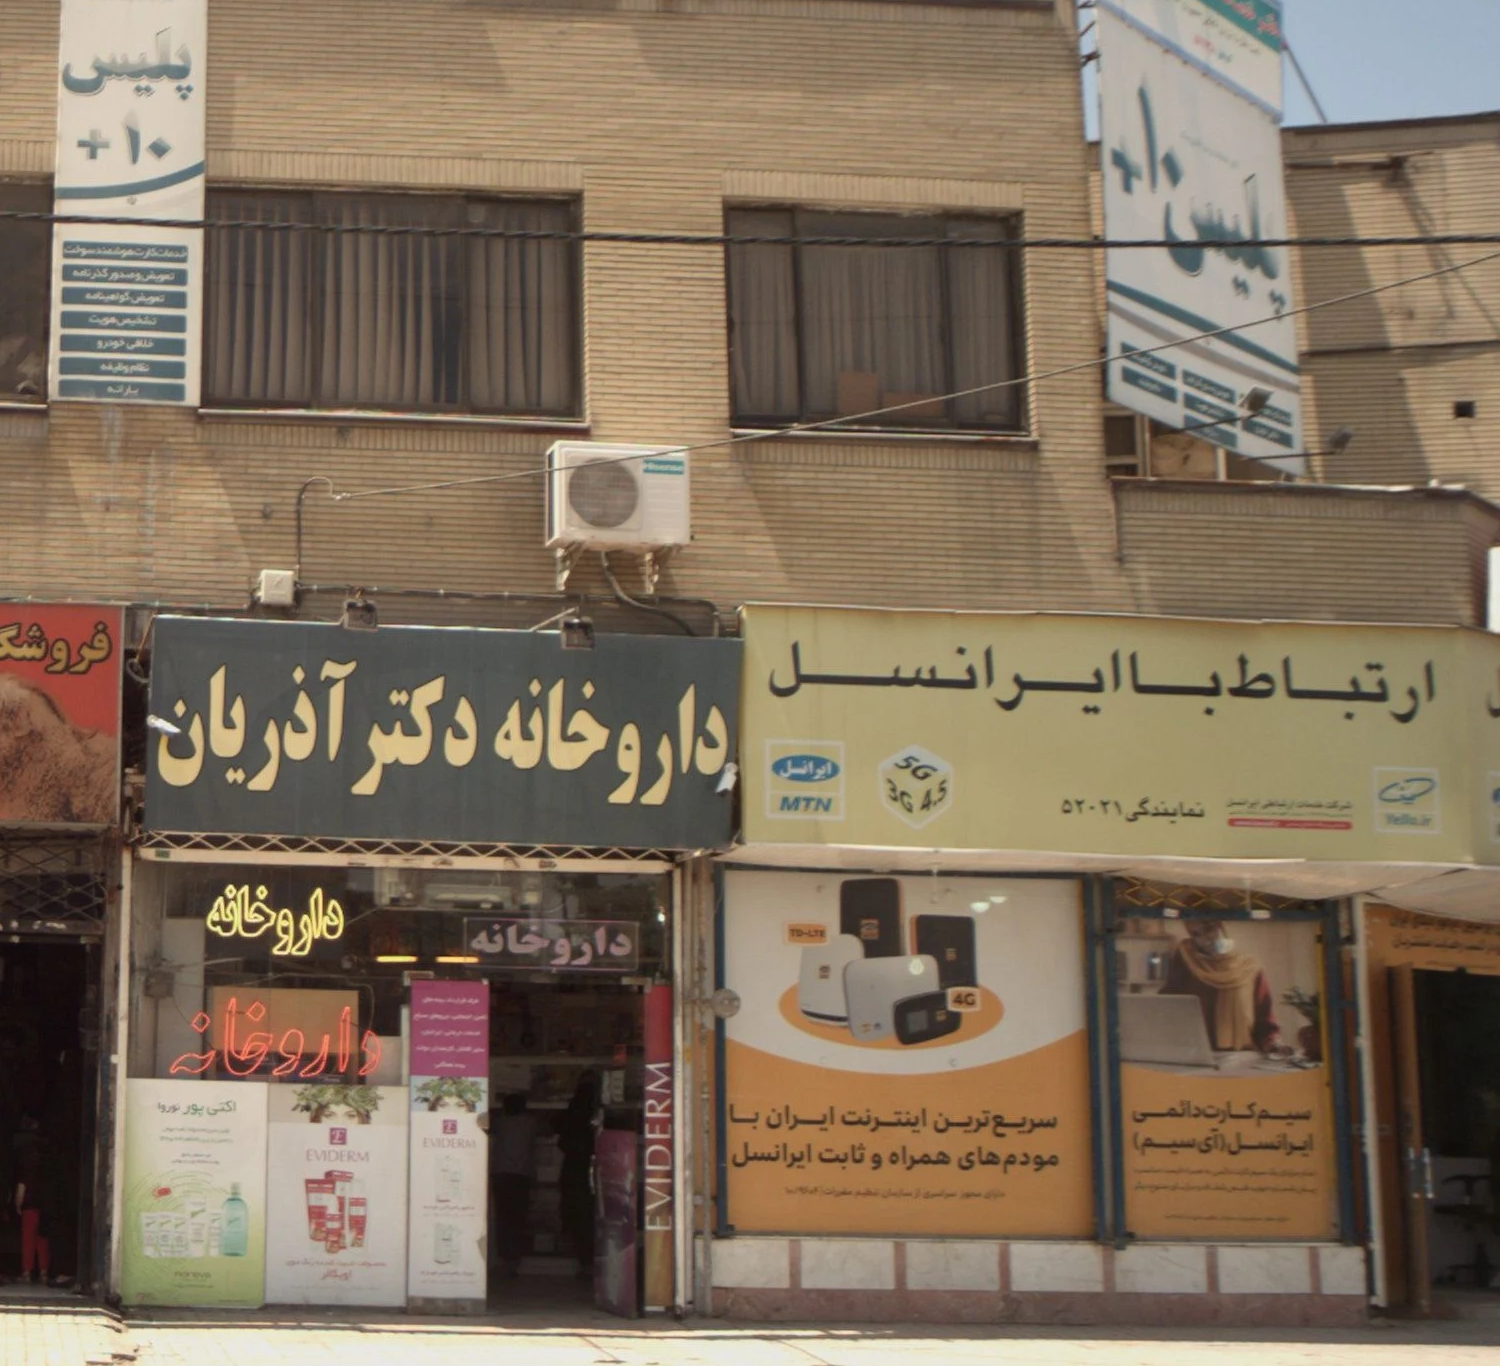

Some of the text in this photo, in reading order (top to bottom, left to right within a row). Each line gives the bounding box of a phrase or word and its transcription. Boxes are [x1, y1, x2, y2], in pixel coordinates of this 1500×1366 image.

[62, 26, 195, 101] پلیس
[767, 641, 1121, 714] ایرانسل
[1129, 650, 1222, 716] با
[1227, 653, 1435, 723] ارتباط
[157, 659, 729, 806] داروخانه دکتر آذریان
[780, 759, 833, 780] ایرانسل
[894, 755, 938, 781] 5G
[779, 796, 833, 813] MTN
[886, 777, 914, 813] 3G
[1125, 796, 1205, 824] نمایندگی
[207, 883, 345, 956] داروخانه
[789, 928, 827, 937] TD-LTE
[470, 922, 634, 966] داروخانه
[952, 993, 975, 1007] 4G
[170, 996, 383, 1077] داروخانه
[729, 1102, 760, 1129] با
[765, 1105, 835, 1130] ایران
[841, 1107, 927, 1130] اینترنت
[1132, 1100, 1312, 1128] سیم کارت دائمی
[306, 1148, 370, 1163] EVIDERM
[423, 1137, 477, 1149] EVIDERM
[645, 1060, 673, 1233] EVIDERM
[732, 1141, 813, 1170] ایرانسل
[818, 1142, 865, 1167] ثابت
[1227, 1131, 1314, 1157] ایرانسل
[872, 1151, 883, 1170] و
[890, 1144, 951, 1170] همراه
